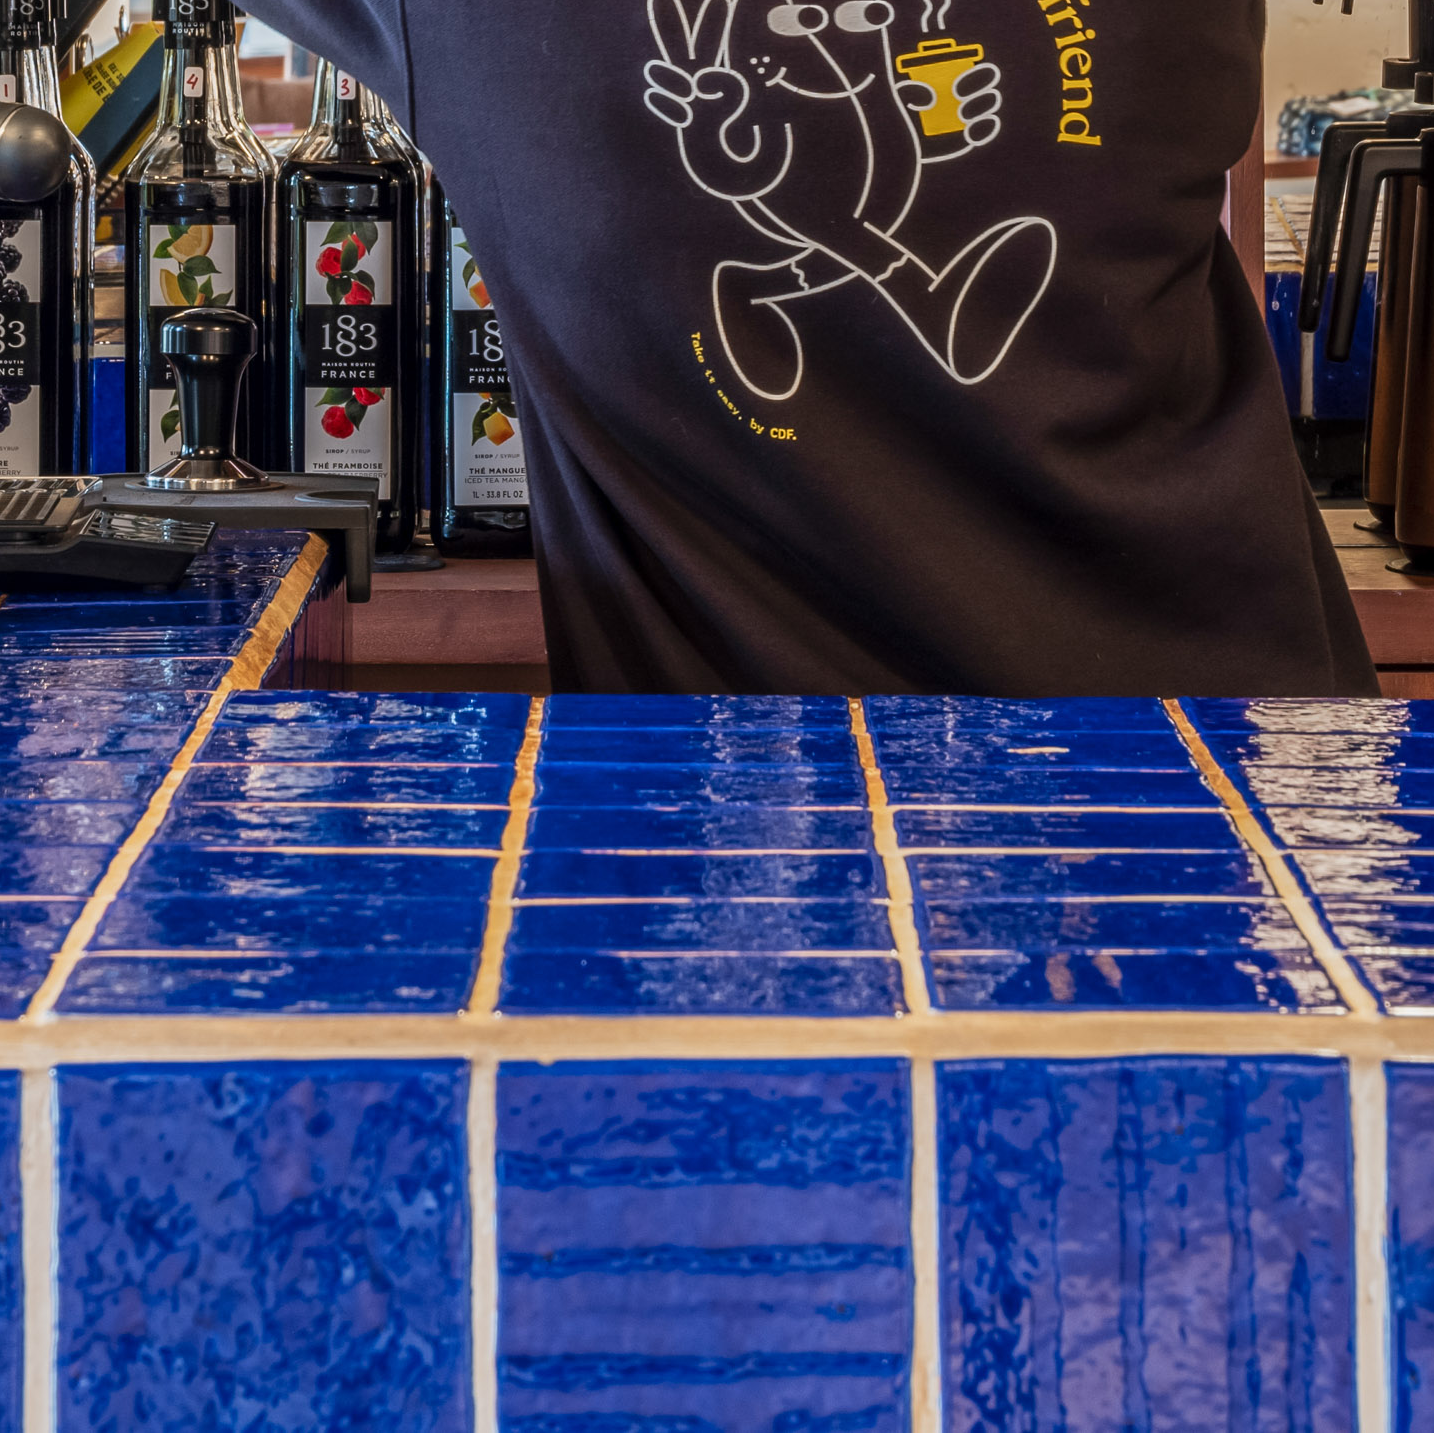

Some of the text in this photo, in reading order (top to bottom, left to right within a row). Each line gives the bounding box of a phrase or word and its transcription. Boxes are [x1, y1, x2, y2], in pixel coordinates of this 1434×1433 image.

[186, 73, 199, 91] 4
[340, 78, 350, 97] 3
[321, 314, 378, 357] 183
[469, 319, 505, 363] 18
[320, 369, 376, 379] FRANCE
[690, 332, 798, 441] Take it easy, by CDF.
[312, 461, 383, 470] THÉ FRAMBOISE
[469, 466, 526, 475] THÉ MANGUE
[472, 490, 524, 499] 1L 33.8 FL OZ
